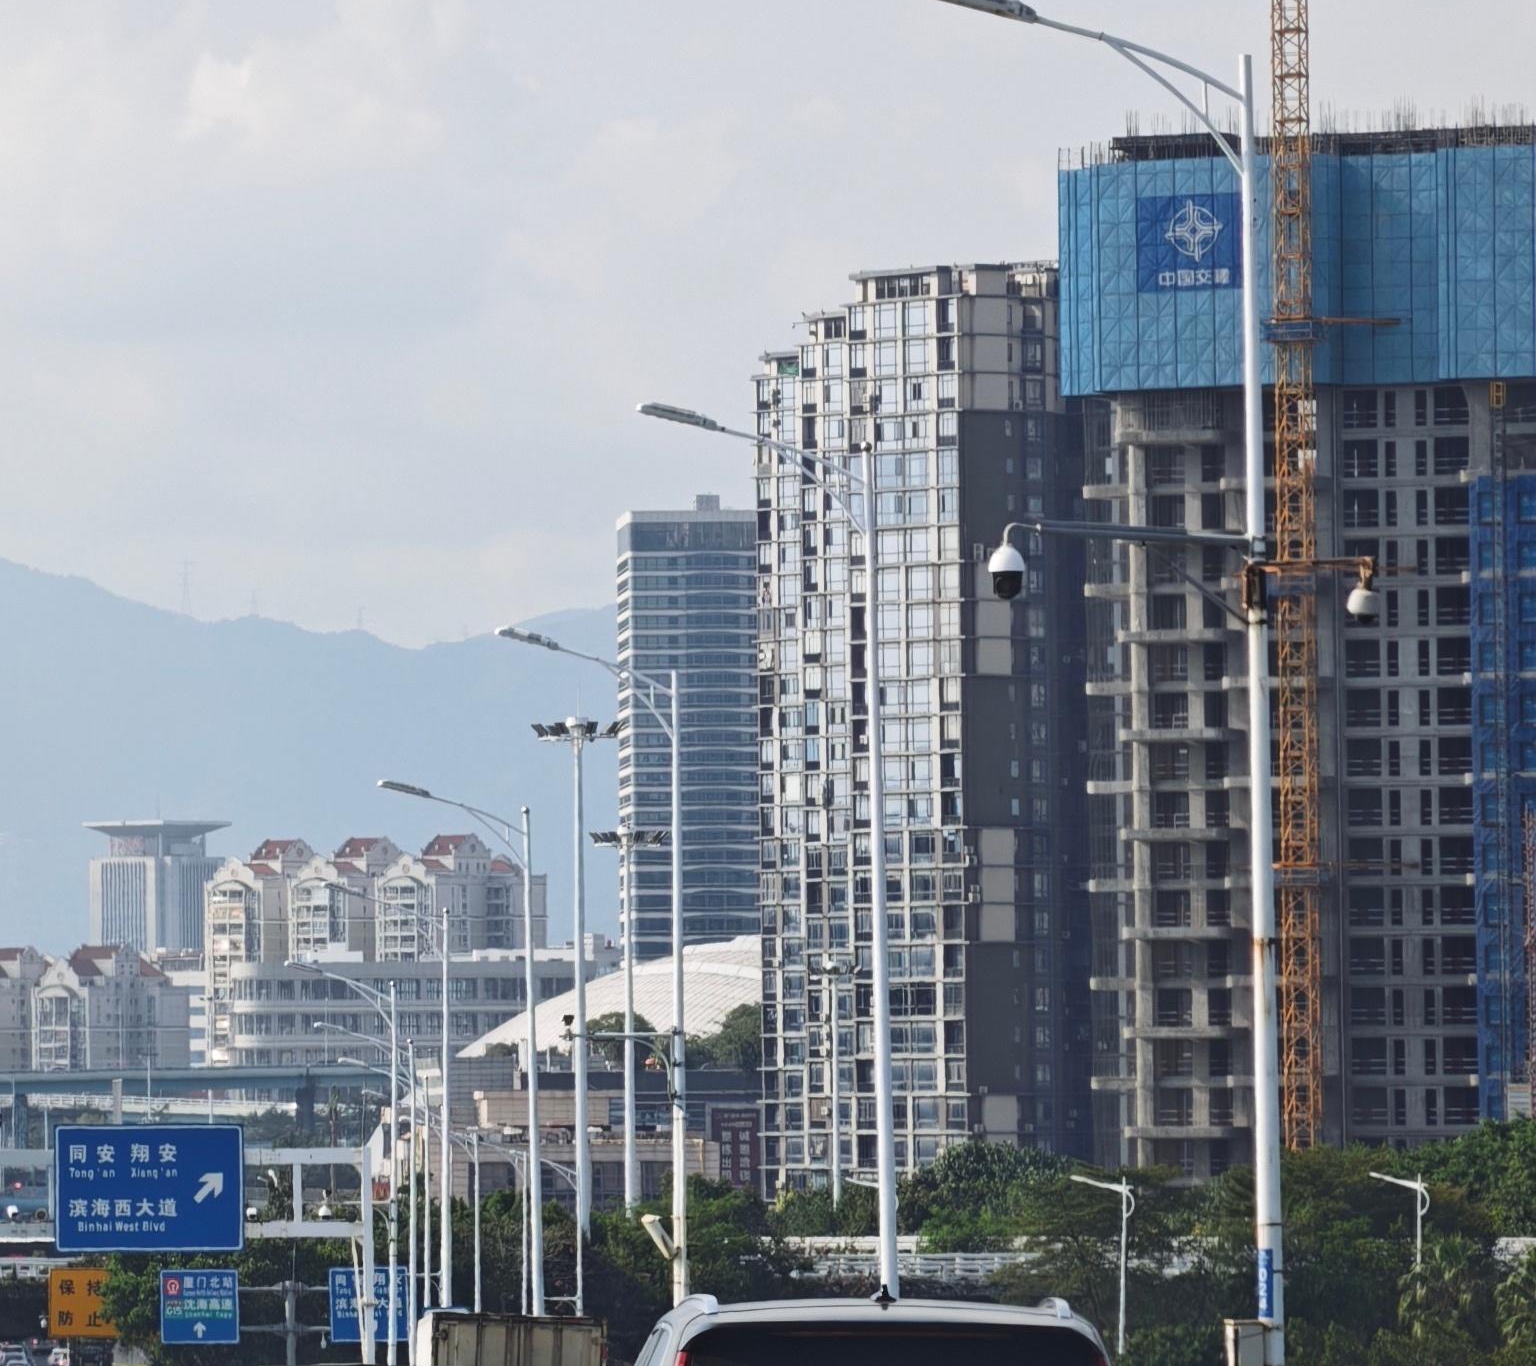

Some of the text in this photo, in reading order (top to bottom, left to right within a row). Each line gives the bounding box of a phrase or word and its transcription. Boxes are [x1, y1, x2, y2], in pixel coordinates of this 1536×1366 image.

[1159, 268, 1230, 286] 中国交建
[69, 1143, 177, 1164] 同安 翔安
[68, 1198, 178, 1217] 滨海西大道
[78, 1221, 166, 1232] Binhai West Blvd
